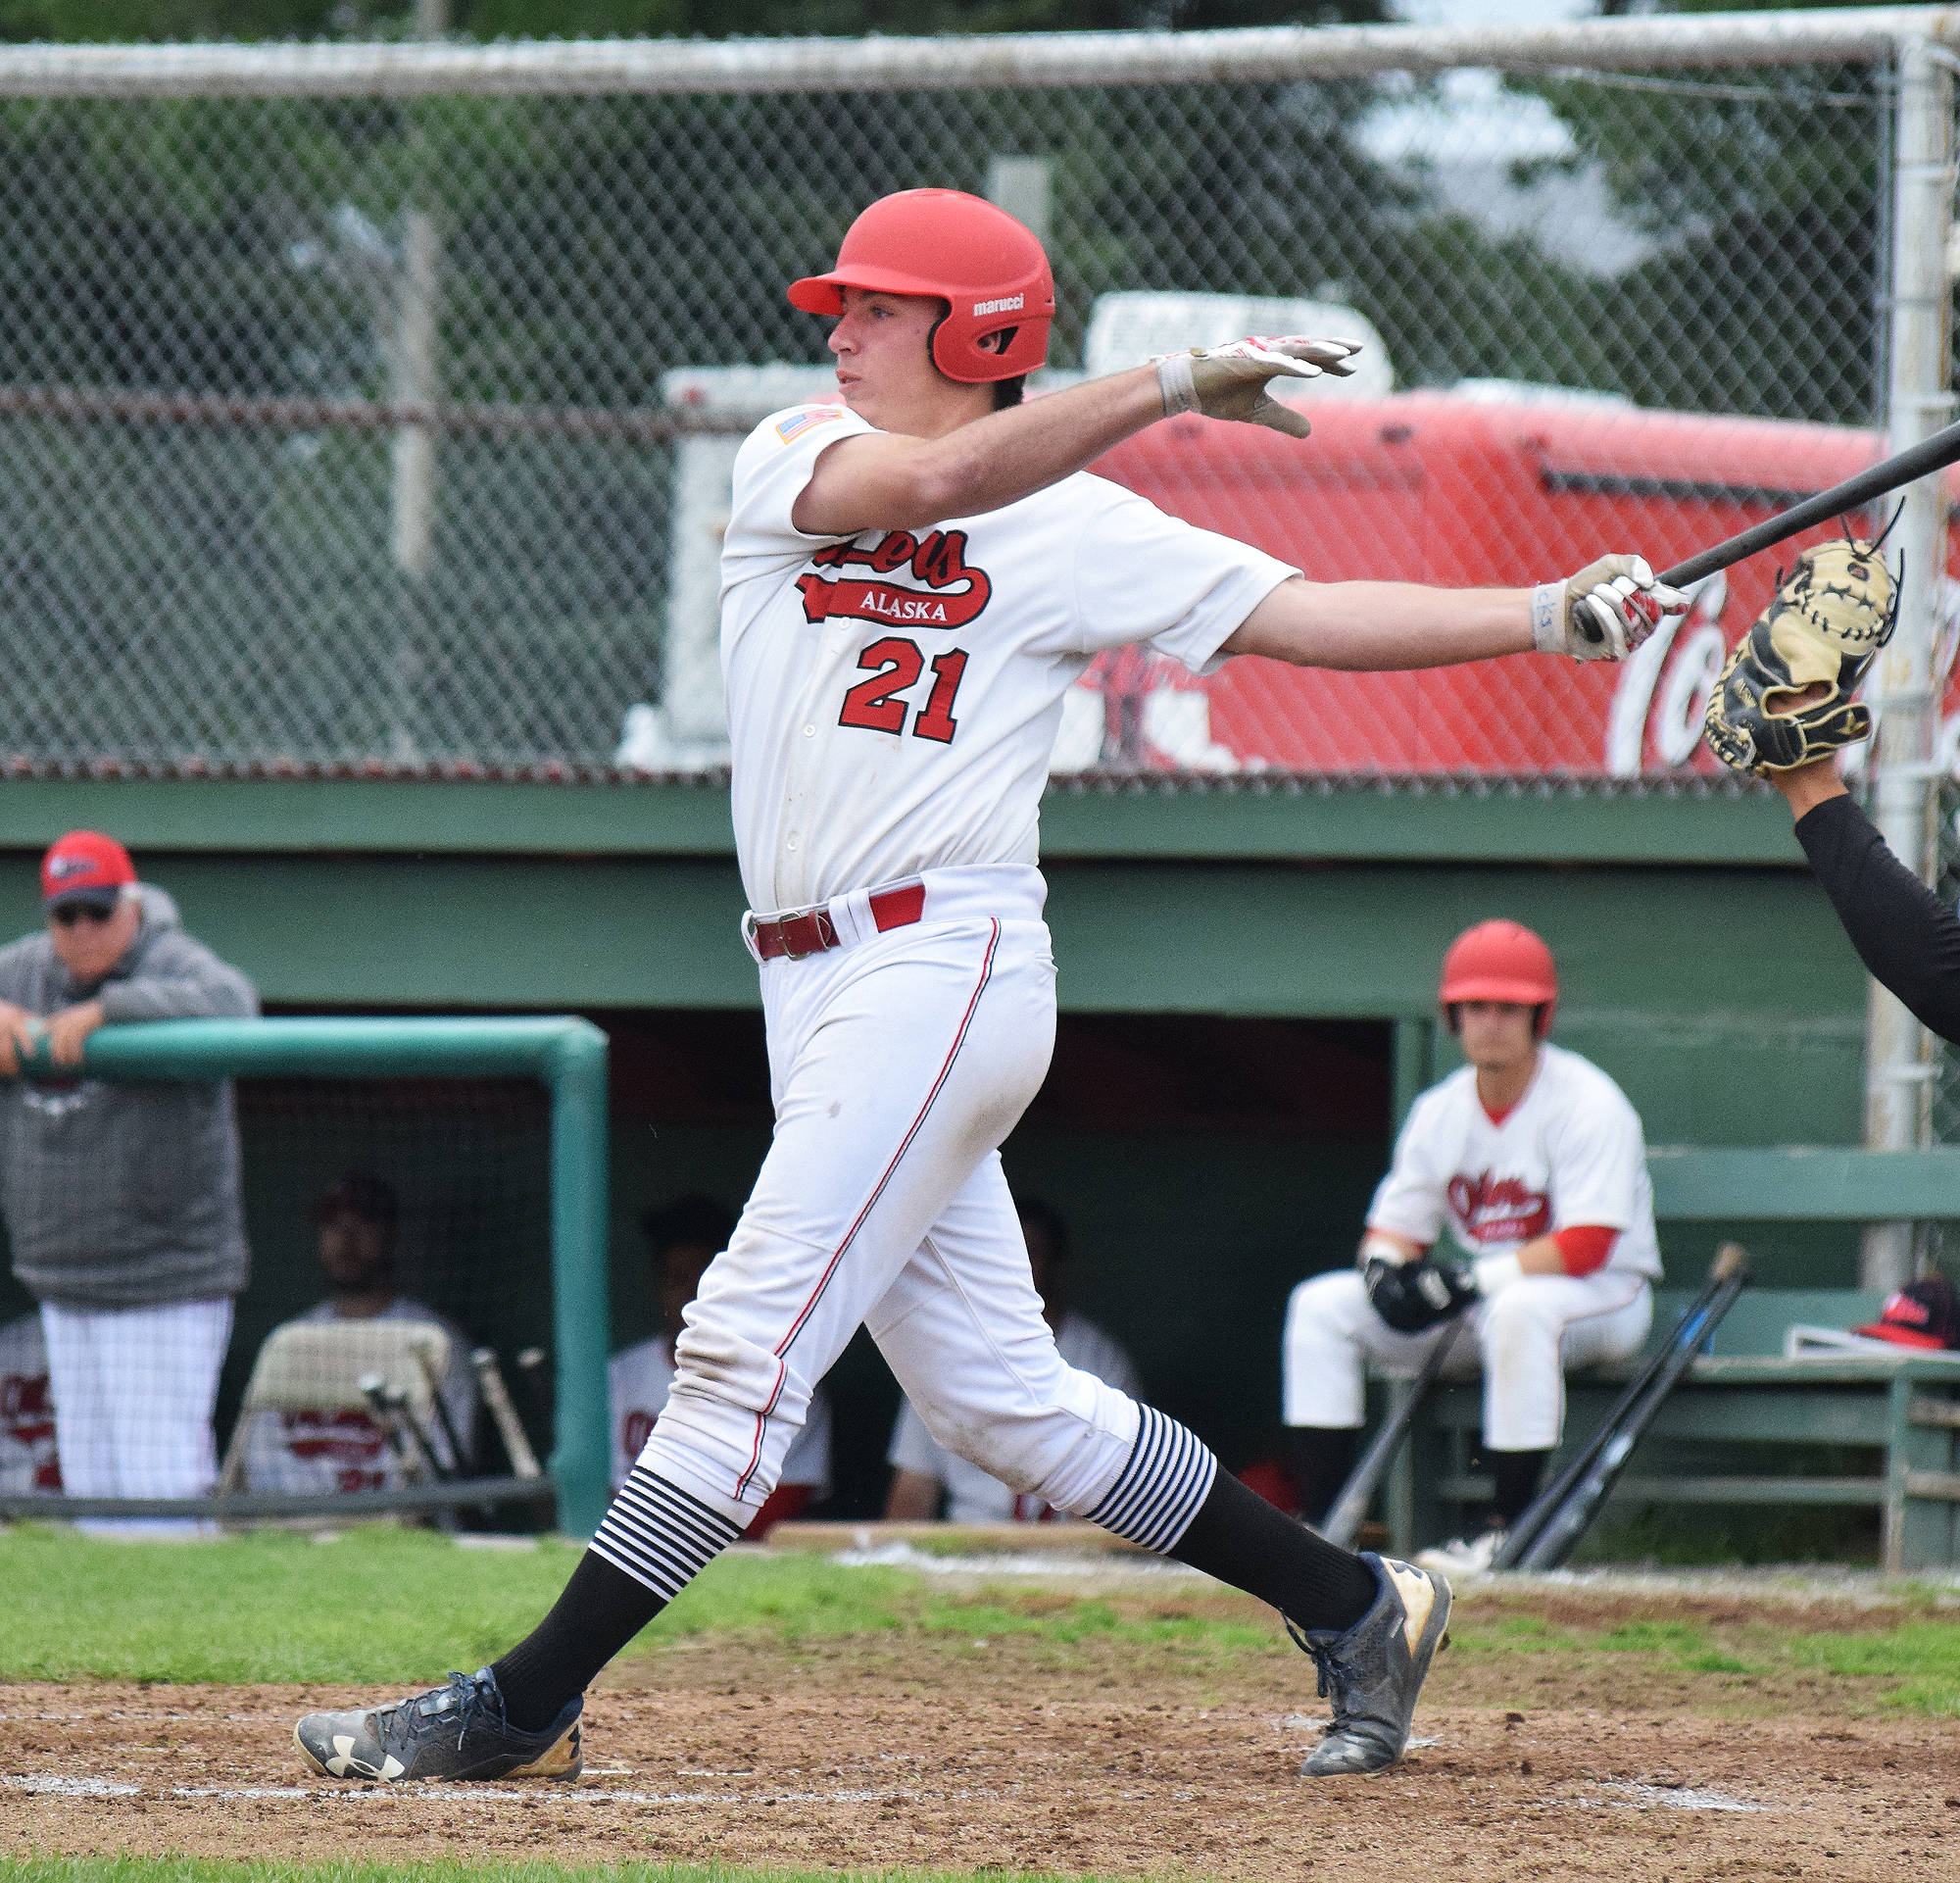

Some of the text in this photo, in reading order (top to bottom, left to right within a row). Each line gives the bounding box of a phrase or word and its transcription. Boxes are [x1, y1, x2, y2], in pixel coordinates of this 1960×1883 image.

[973, 292, 1024, 317] marucci
[859, 591, 948, 622] ALASKA
[838, 635, 970, 745] 21
